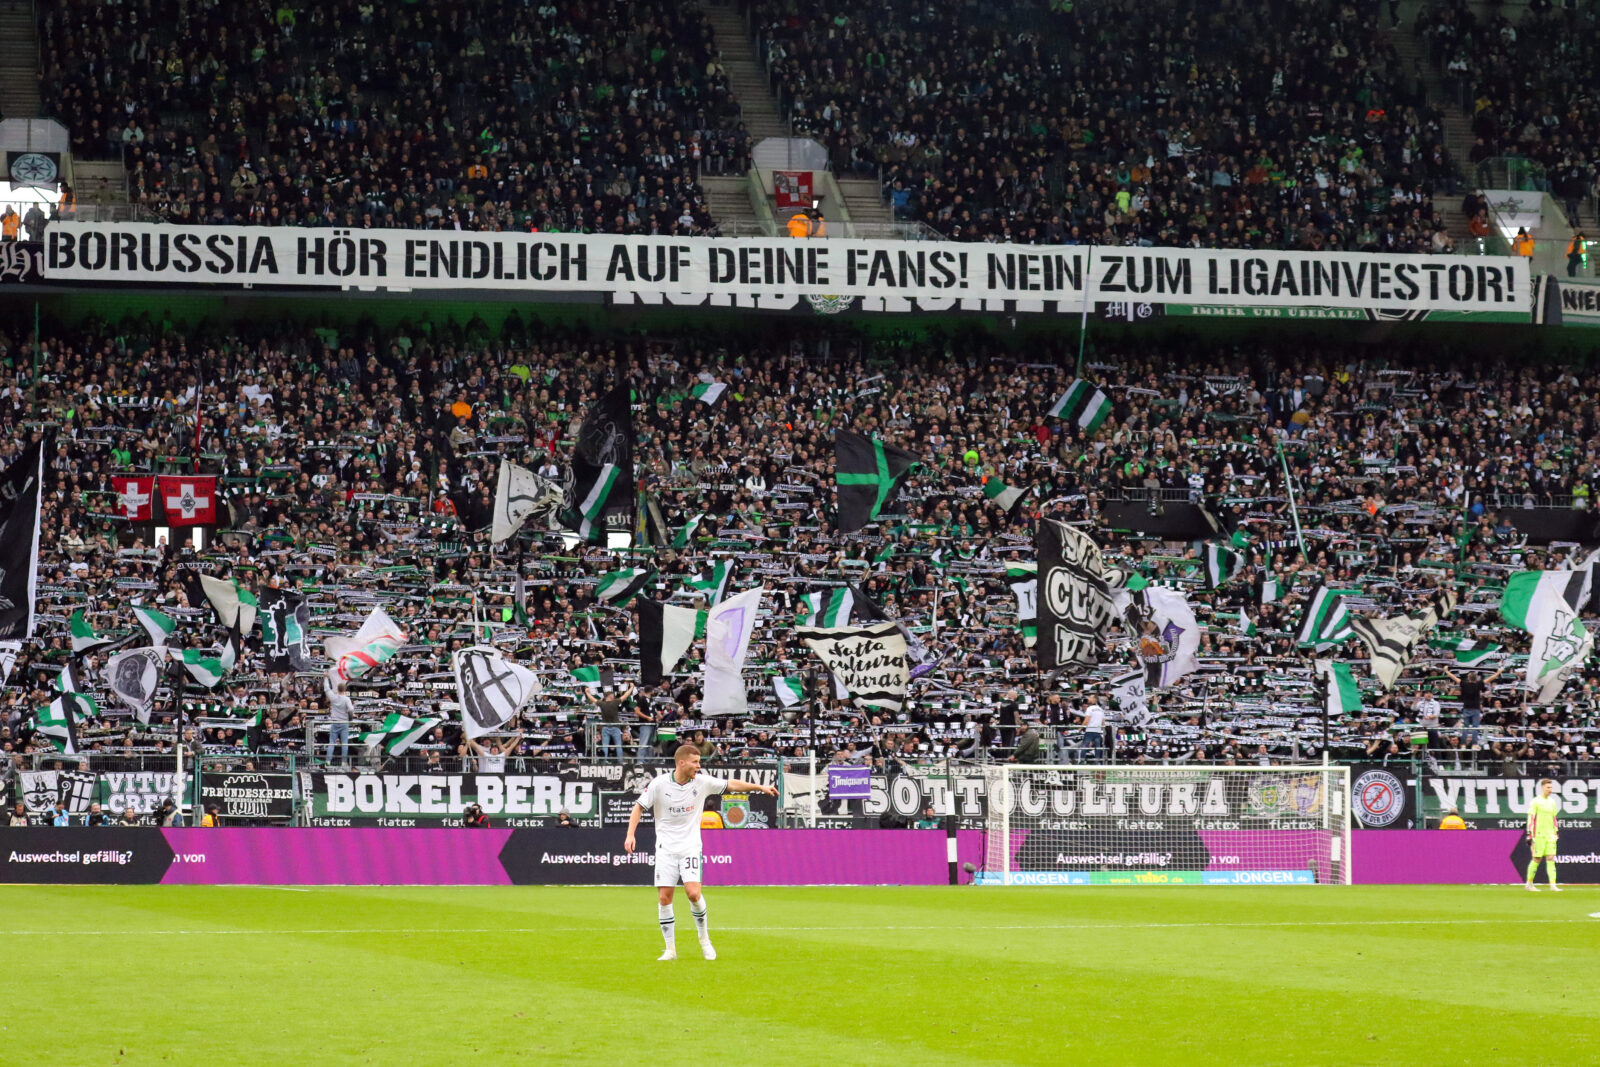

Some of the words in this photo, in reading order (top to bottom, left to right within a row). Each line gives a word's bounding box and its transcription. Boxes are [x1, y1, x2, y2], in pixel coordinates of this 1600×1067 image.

[48, 231, 279, 275] BORUSSIA
[297, 230, 387, 277] HÖR
[405, 239, 587, 281] ENDLICH
[606, 244, 691, 282] AUF
[708, 247, 829, 285] DEINE
[847, 249, 968, 289] FANS!
[988, 253, 1082, 291] NEIN
[1100, 256, 1192, 295] ZUM
[1208, 258, 1516, 302] LIGAINVESTOR!
[1562, 288, 1600, 311] NIE
[105, 772, 188, 794] VITUS
[202, 786, 293, 799] FREUNDESKREIS
[325, 774, 594, 814] BOKELBERG
[313, 817, 351, 827] flatex
[377, 817, 416, 827] flatex
[441, 817, 464, 827] flat
[506, 817, 544, 828] flatex
[1039, 819, 1087, 830] flatex
[1116, 819, 1164, 830] flatex
[1193, 819, 1240, 830] flatex
[1268, 819, 1316, 830] flatex
[8, 851, 80, 863] Auswechsel
[82, 850, 133, 865] gefällig?
[183, 854, 206, 863] von
[541, 852, 610, 864] Auswechsel
[613, 851, 655, 866] gefällig
[711, 854, 732, 864] von
[684, 857, 699, 869] 30
[1057, 853, 1123, 865] Auswechsel
[1125, 852, 1172, 866] gefällig?
[1219, 854, 1240, 864] von
[1231, 871, 1294, 883] JONGEN
